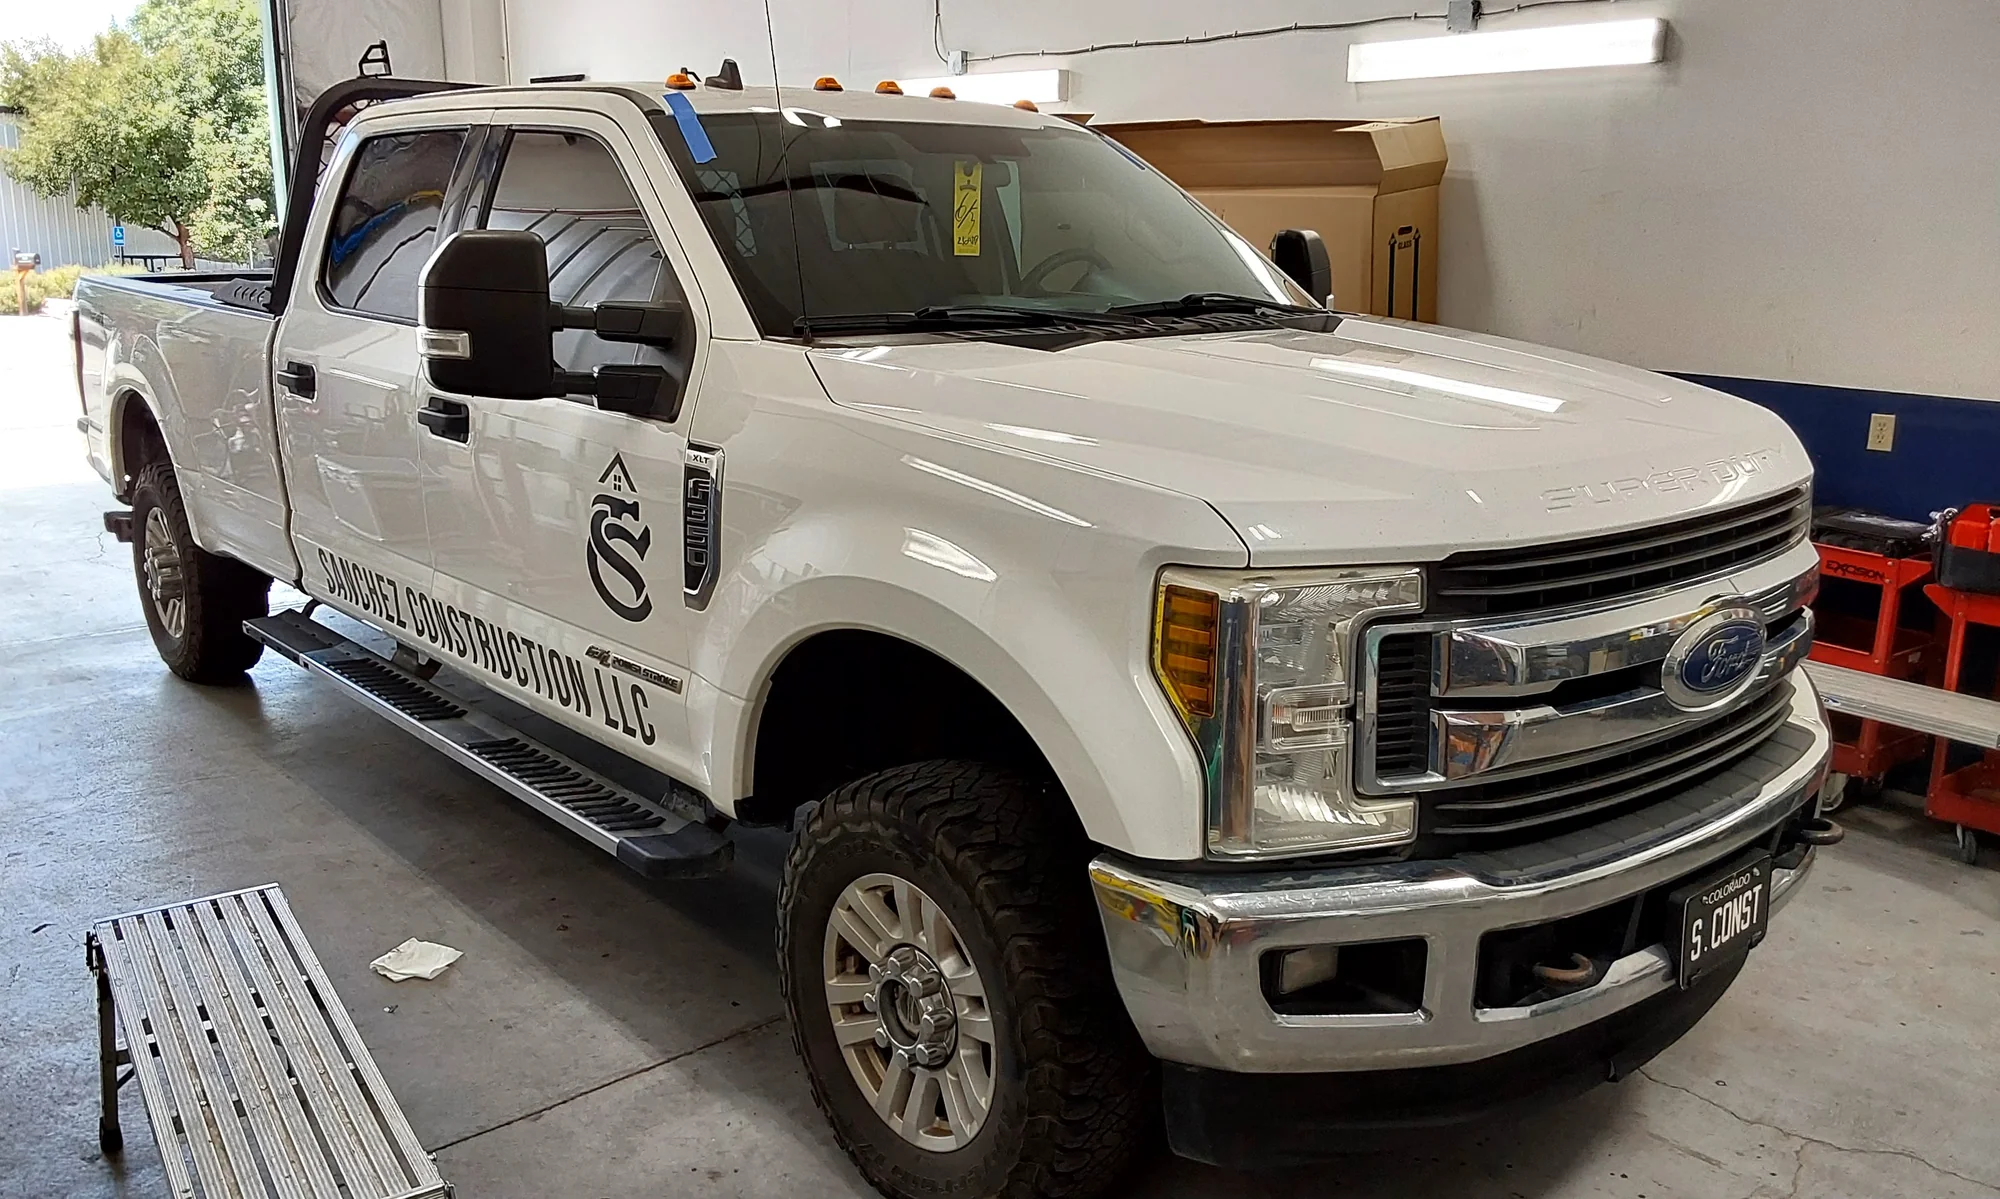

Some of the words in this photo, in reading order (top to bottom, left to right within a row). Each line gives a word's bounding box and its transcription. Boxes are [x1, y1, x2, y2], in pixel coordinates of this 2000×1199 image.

[692, 454, 710, 465] XLT
[1540, 467, 1706, 513] SUPER
[1705, 443, 1782, 484] DUTY
[317, 548, 407, 629] SANCHEZ
[405, 586, 592, 718] CONSTRUCTION
[594, 667, 656, 746] LLC
[1701, 635, 1756, 683] Ford
[1708, 872, 1751, 904] COLORADO
